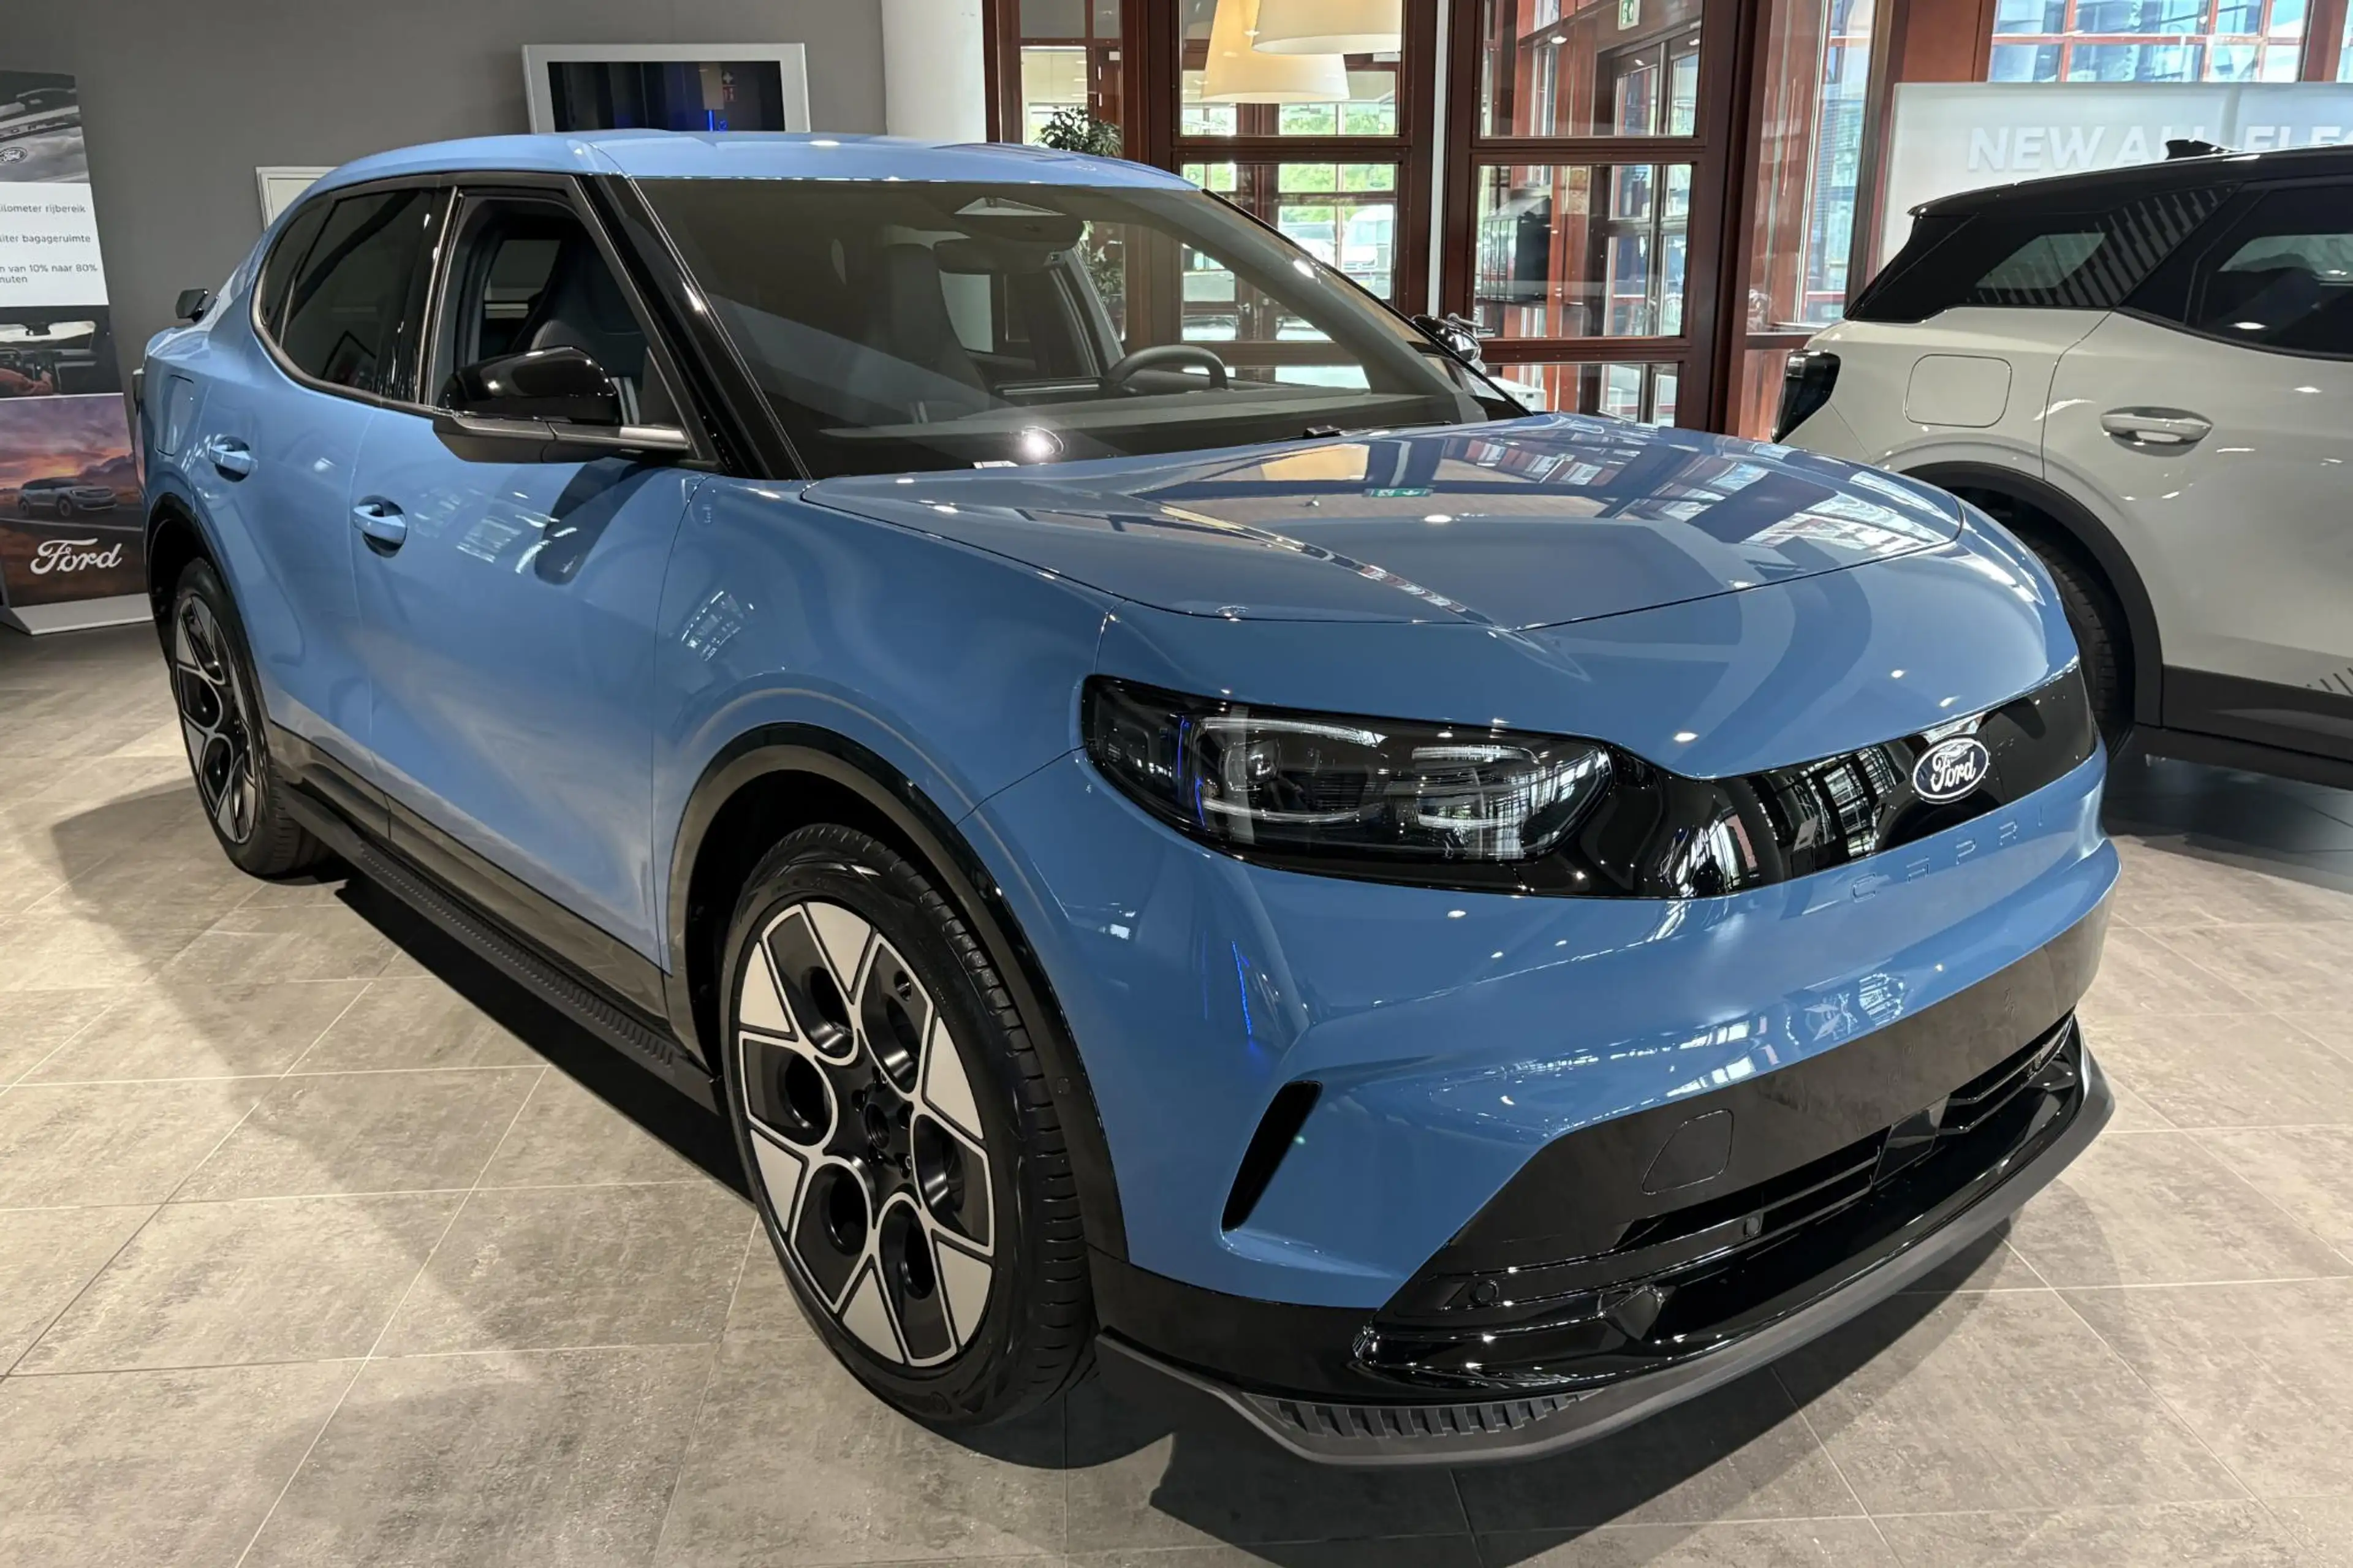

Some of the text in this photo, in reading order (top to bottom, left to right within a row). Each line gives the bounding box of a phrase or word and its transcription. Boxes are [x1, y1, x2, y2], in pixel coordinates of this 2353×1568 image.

[1967, 126, 2106, 171] NEW
[0, 203, 86, 214] ilometer rijbereik
[22, 235, 91, 244] bagageruimte
[29, 263, 50, 273] 10%
[75, 263, 99, 272] 80%
[30, 538, 123, 575] Ford
[1931, 746, 1977, 792] Ford
[1849, 805, 2045, 904] CAPRI
